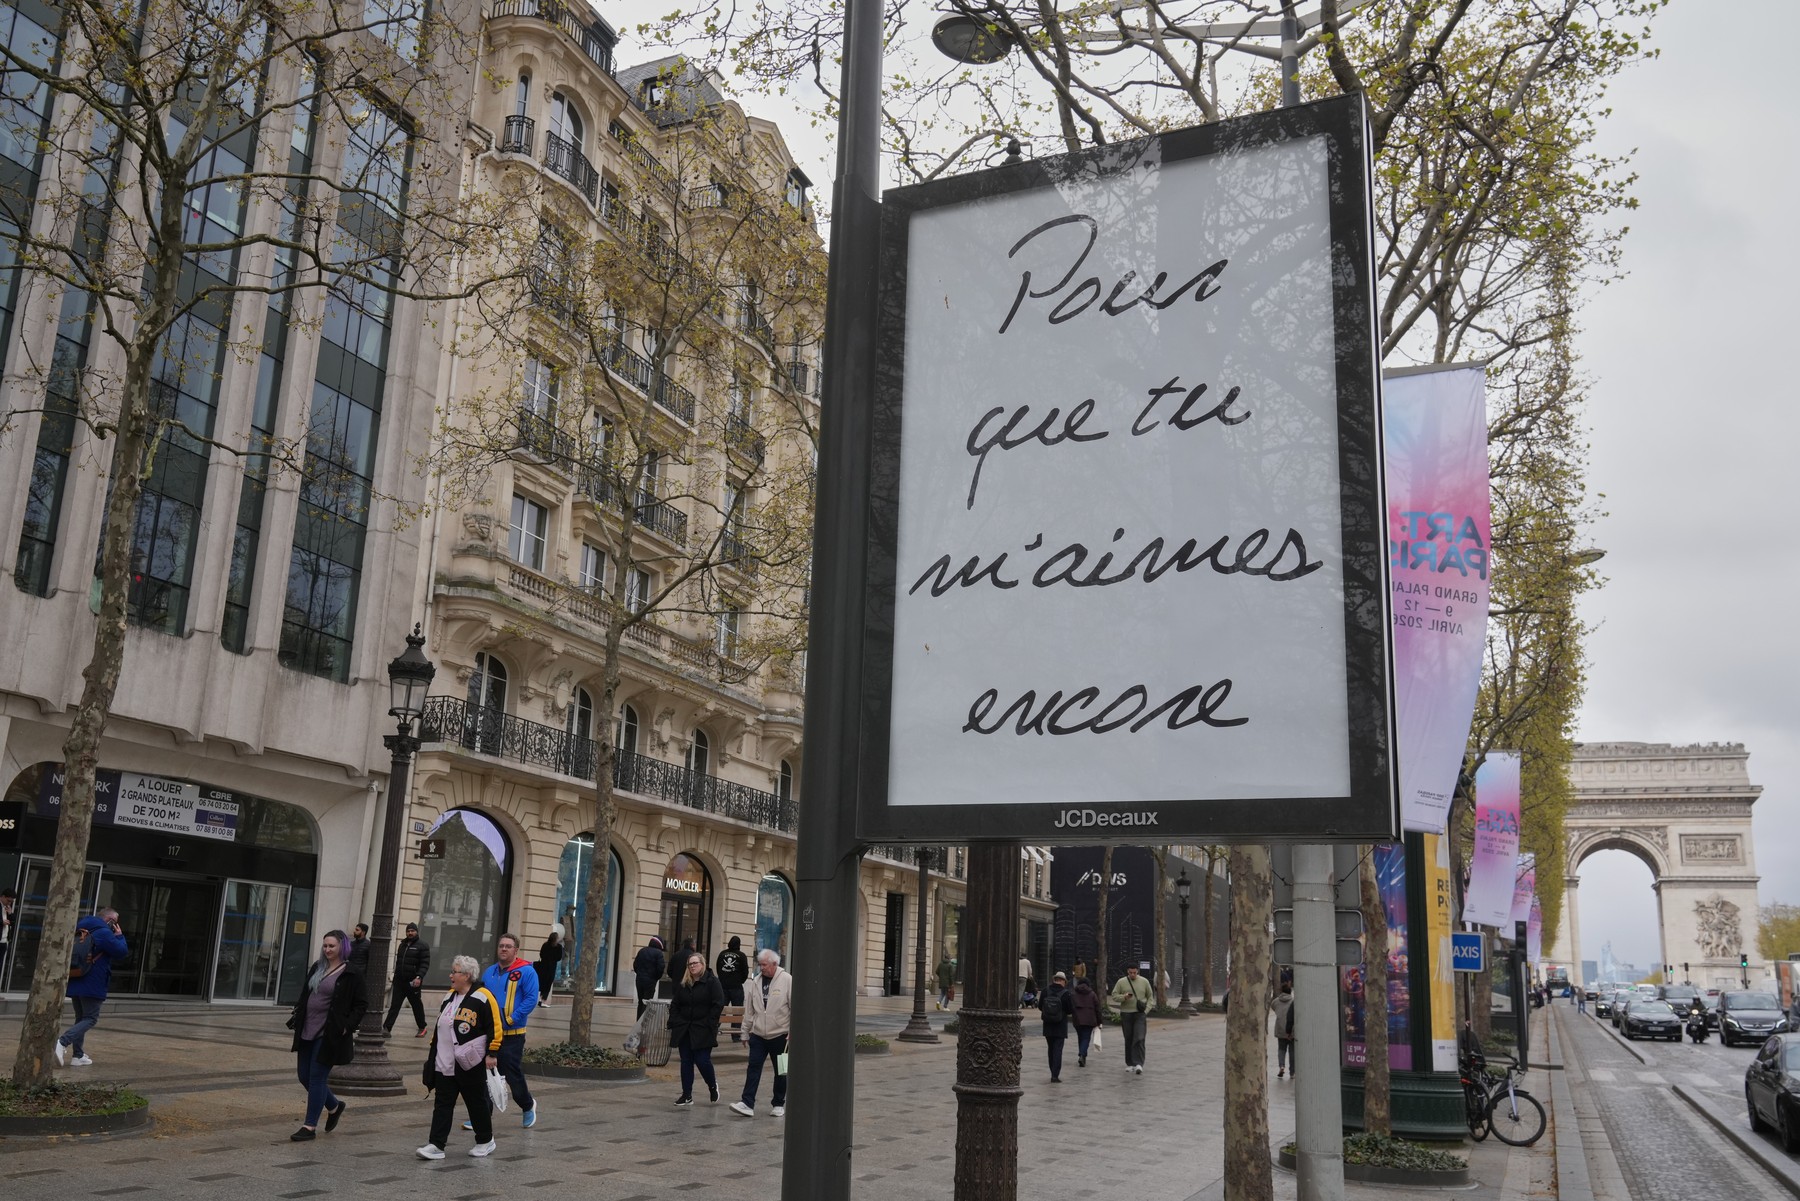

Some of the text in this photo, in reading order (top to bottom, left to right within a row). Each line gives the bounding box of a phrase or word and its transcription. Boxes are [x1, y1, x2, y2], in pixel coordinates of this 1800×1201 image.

[999, 214, 1229, 334] Pour
[966, 376, 1252, 511] que tu
[908, 527, 1324, 598] m'aimes
[962, 678, 1250, 736] encore
[148, 780, 182, 795] LOUER
[210, 790, 232, 801] CBRE
[49, 795, 108, 812] 06 63
[121, 789, 194, 810] 2 GRANDS PLATEAUX
[133, 804, 147, 816] DE
[148, 807, 166, 819] 700
[1054, 809, 1159, 828] JCDecaux
[117, 815, 149, 826] RENOVES
[154, 821, 190, 832] CLIMATISES
[196, 824, 203, 832] 07
[168, 845, 181, 856] 117
[665, 877, 700, 893] MONCLER
[1452, 945, 1480, 959] AXIS
